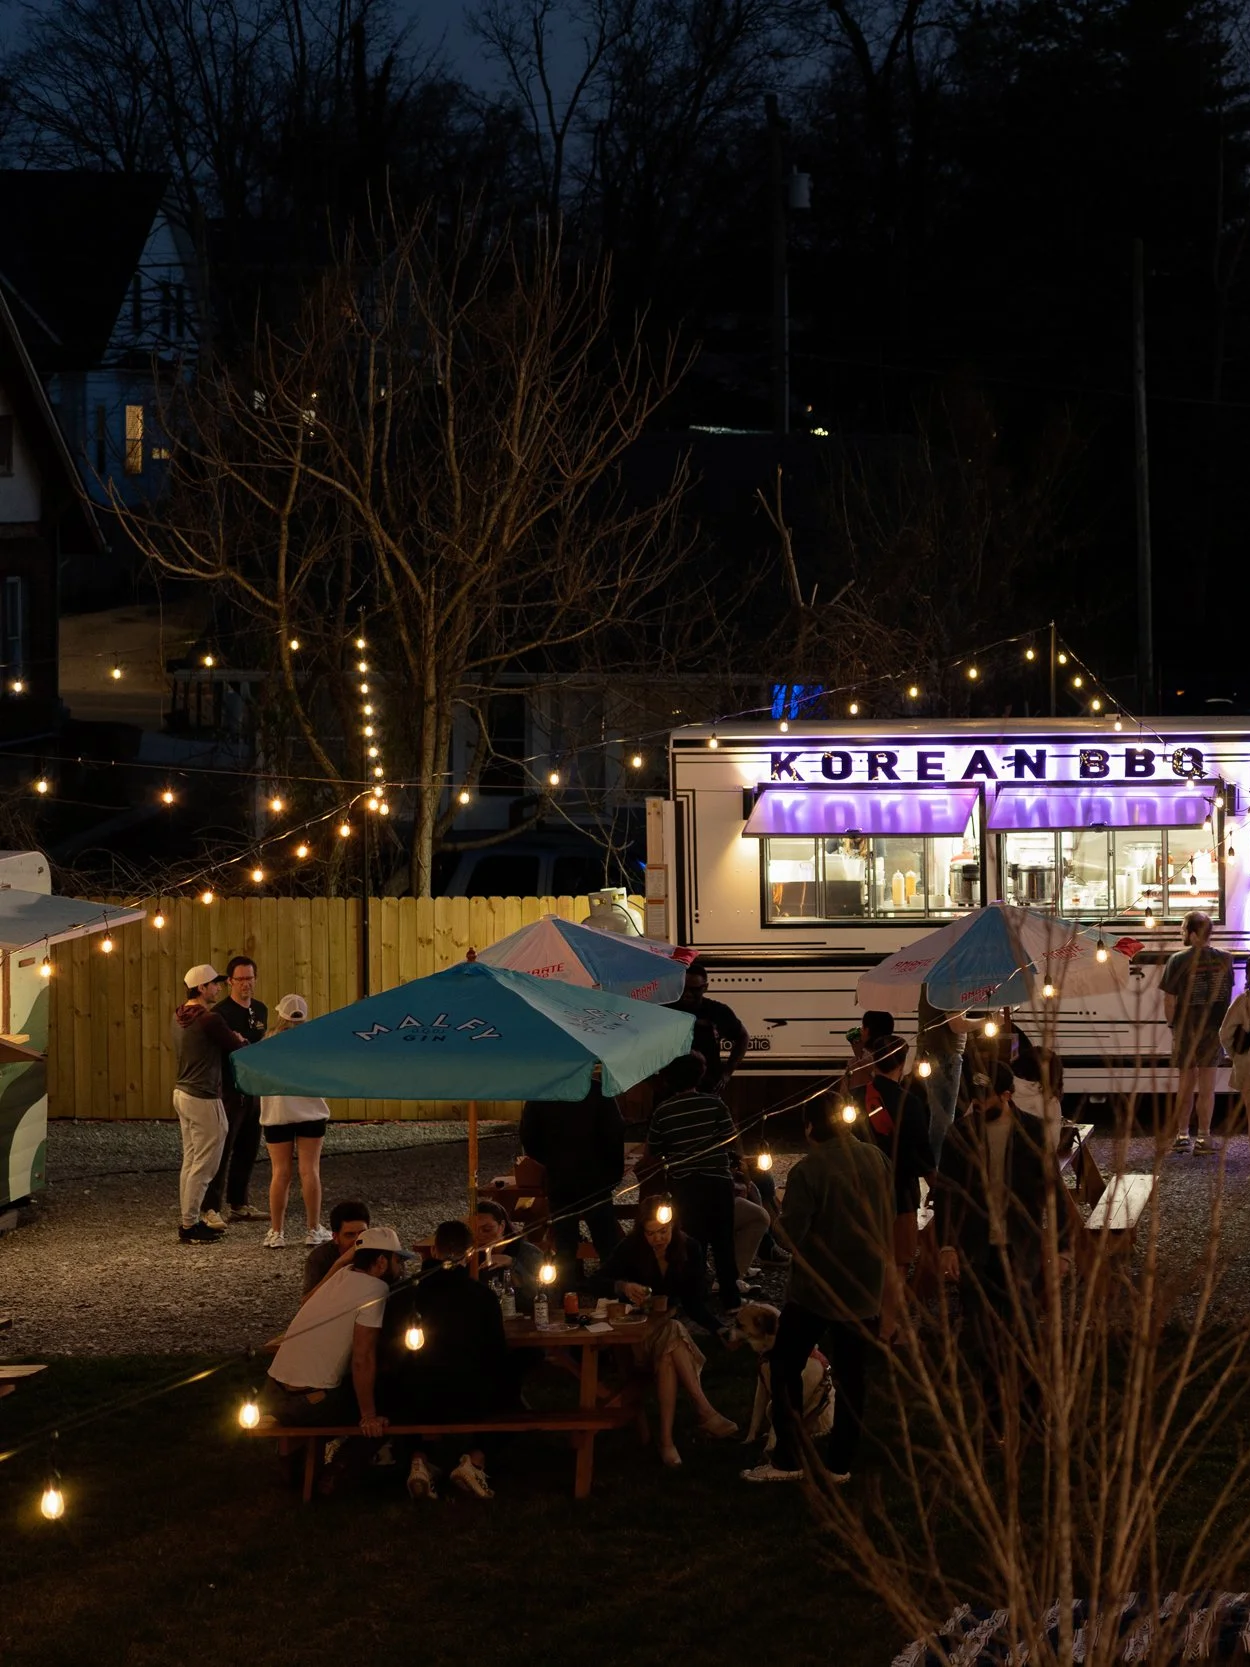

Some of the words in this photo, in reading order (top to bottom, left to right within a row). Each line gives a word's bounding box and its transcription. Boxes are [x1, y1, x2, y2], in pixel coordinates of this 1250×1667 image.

[769, 748, 1047, 782] KOREAN
[1079, 747, 1208, 780] BBQ
[353, 1012, 502, 1042] MALFY
[403, 1034, 446, 1042] GIN
